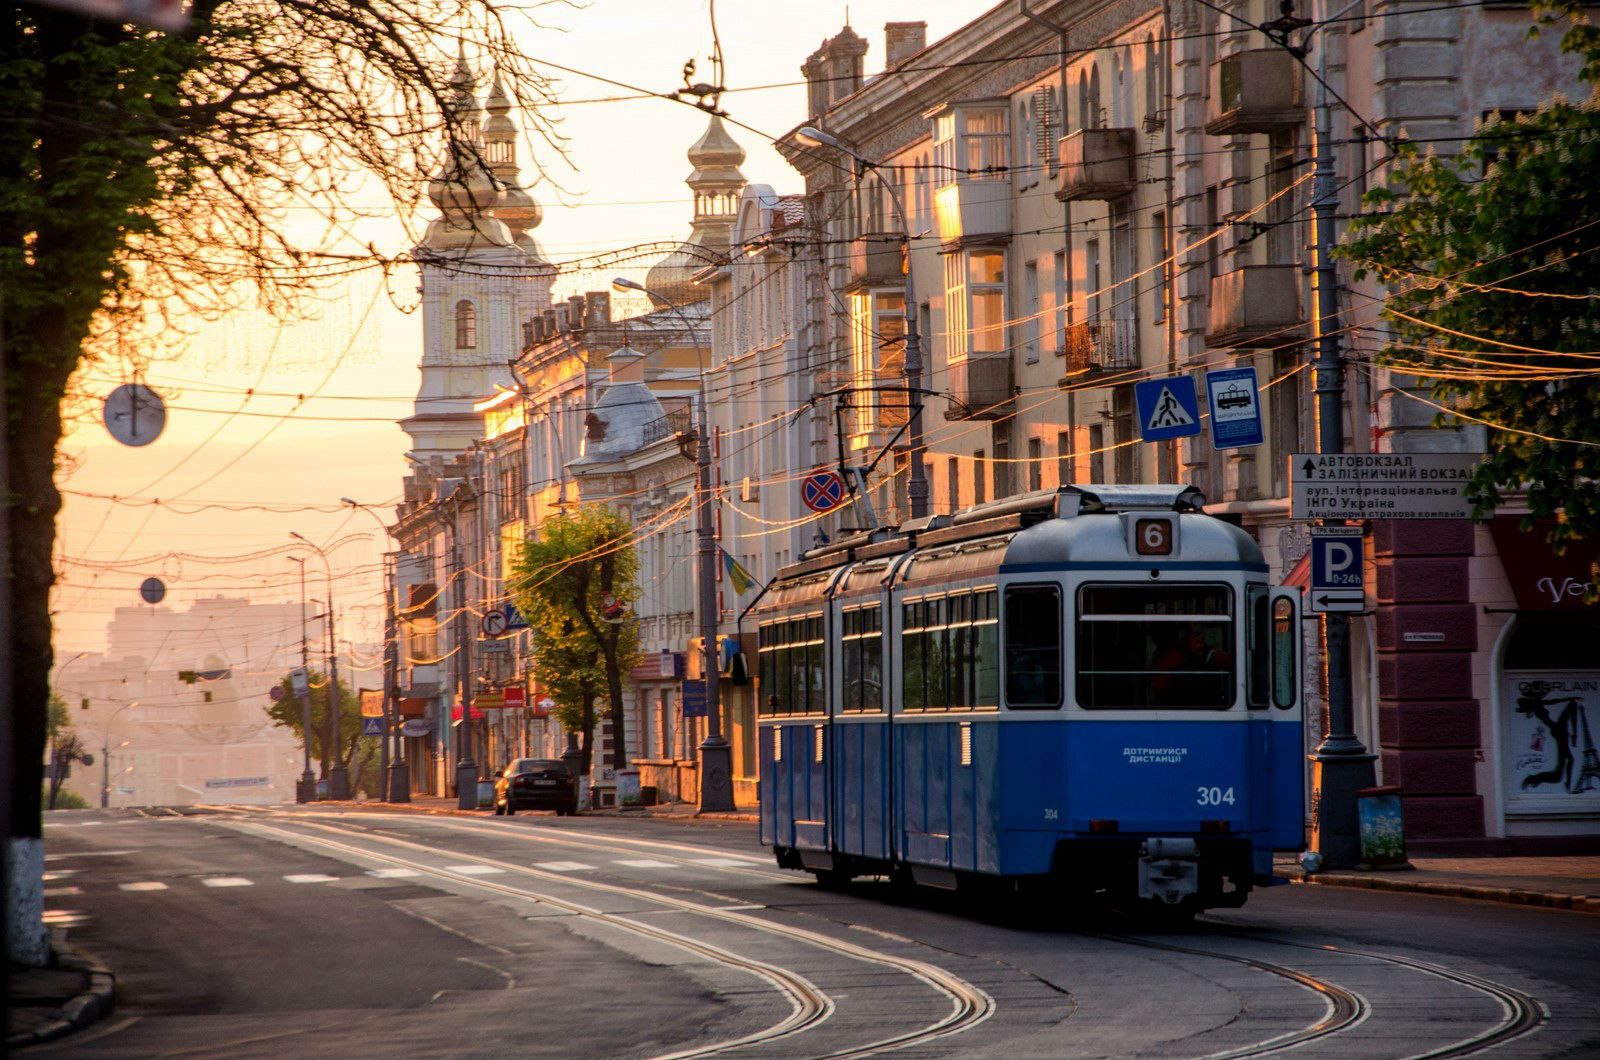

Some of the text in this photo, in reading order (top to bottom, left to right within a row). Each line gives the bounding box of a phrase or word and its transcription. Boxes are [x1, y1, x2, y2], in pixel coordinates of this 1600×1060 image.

[1319, 456, 1413, 467] АВТОВОКЗАЛ
[1319, 467, 1417, 479] ЗАЛІЗНИЧНИЙ
[1307, 486, 1458, 498] вул. Інтернаціональна
[1307, 498, 1395, 510] ІНГО Україна
[1308, 509, 1466, 519] Акціонерна страхова компанія
[1144, 523, 1163, 547] 6
[1325, 541, 1354, 583] P
[1333, 574, 1361, 584] 0-24h
[1123, 747, 1187, 756] ДОТРИМУЙСЯ
[1129, 755, 1181, 763] ДИСТАНЦІЇ
[1197, 786, 1235, 806] 304
[1044, 808, 1058, 820] 304
